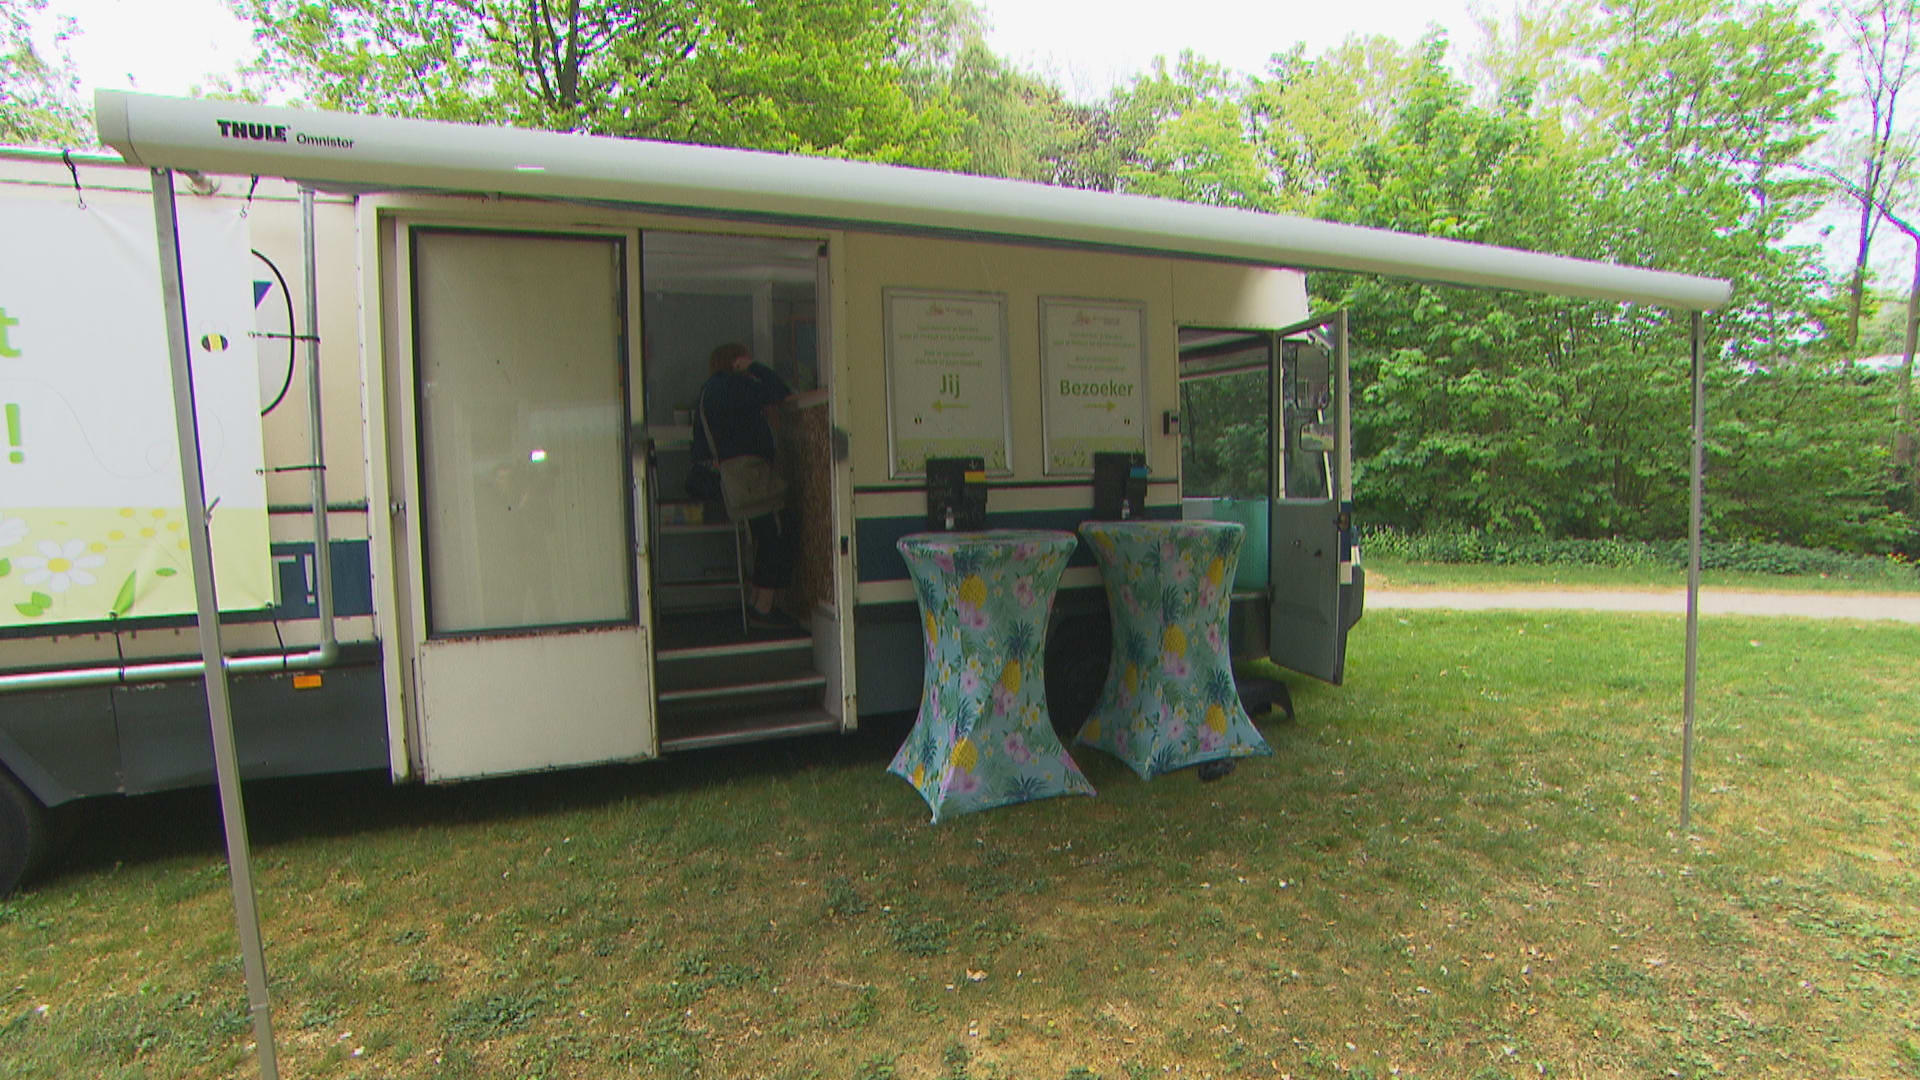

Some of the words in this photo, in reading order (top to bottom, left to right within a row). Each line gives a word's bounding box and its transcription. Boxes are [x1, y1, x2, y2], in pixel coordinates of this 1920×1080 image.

[216, 119, 287, 143] THULE
[296, 132, 355, 149] Omnistor
[939, 374, 961, 399] Jij
[1060, 378, 1134, 397] Bezoeker
